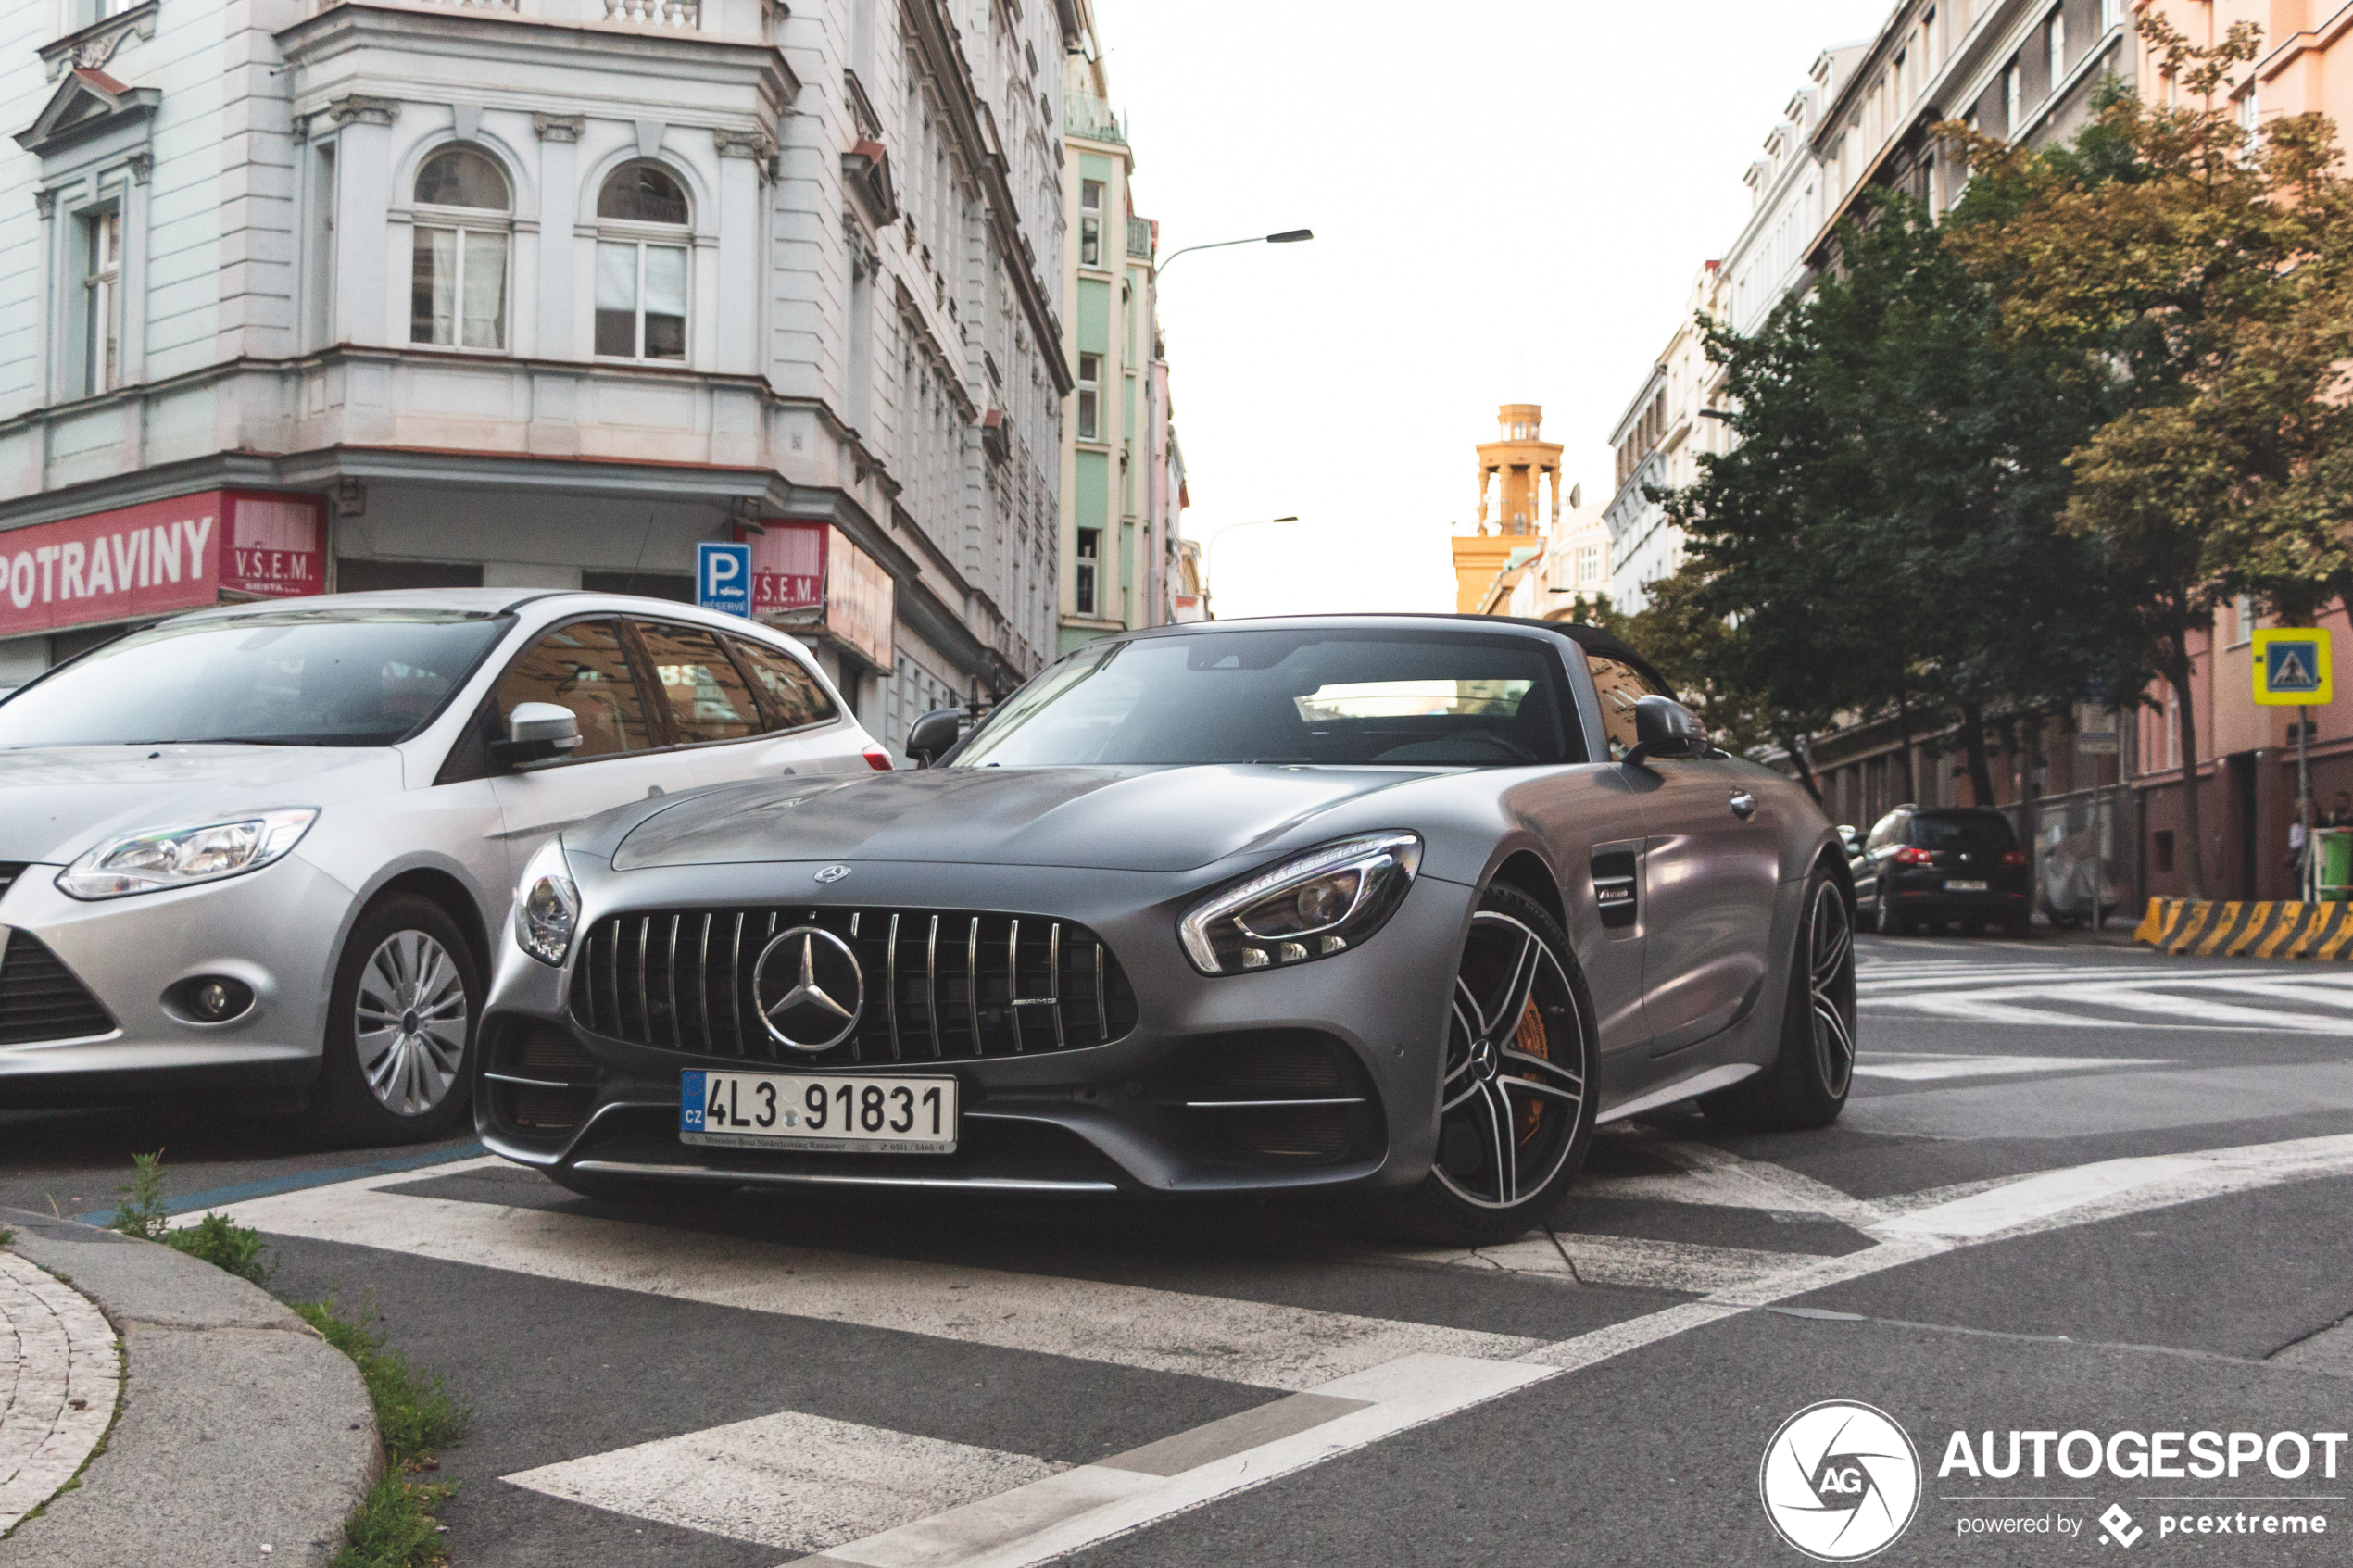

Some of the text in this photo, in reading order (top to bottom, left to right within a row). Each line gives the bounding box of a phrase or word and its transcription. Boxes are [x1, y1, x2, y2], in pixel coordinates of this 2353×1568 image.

[709, 552, 739, 596] P
[686, 1110, 702, 1123] CZ
[707, 1079, 941, 1135] 4L3 91831
